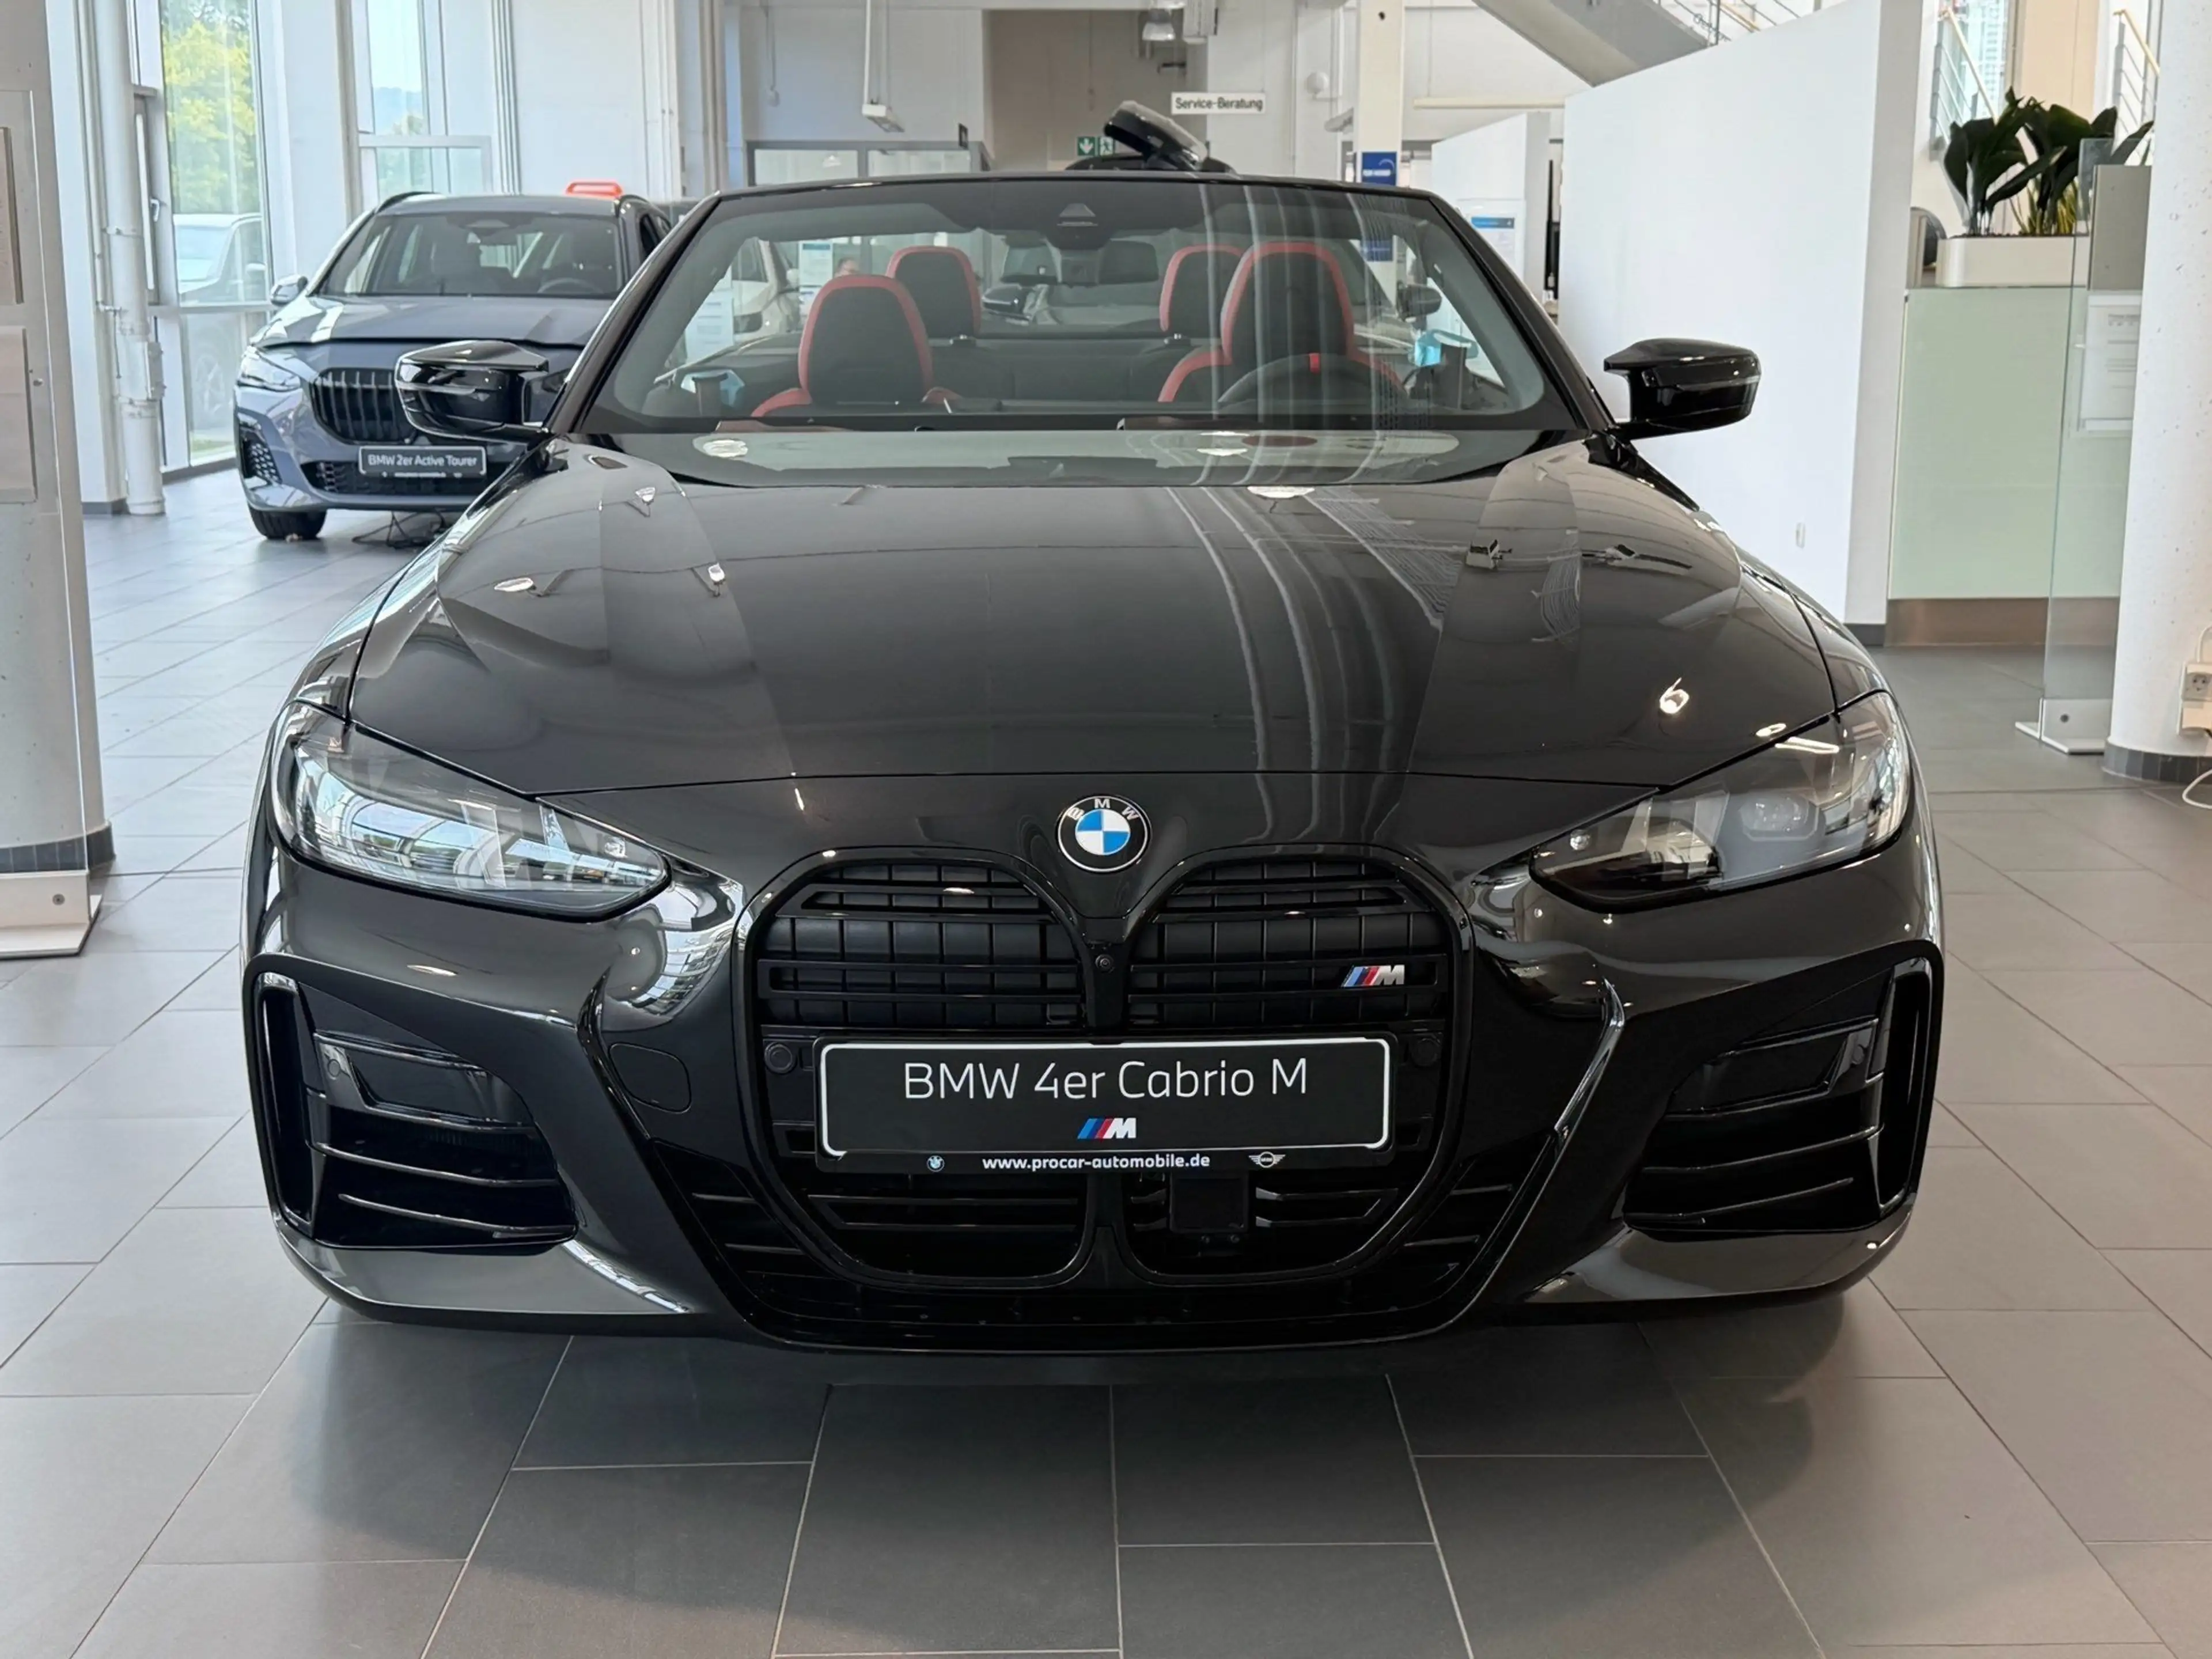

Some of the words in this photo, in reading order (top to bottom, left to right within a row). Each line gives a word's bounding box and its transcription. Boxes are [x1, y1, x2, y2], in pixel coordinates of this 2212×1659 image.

[1175, 96, 1263, 112] Service-Beratung
[368, 454, 395, 466] BMW
[396, 454, 413, 465] 2er
[414, 454, 445, 466] Active
[445, 454, 477, 467] Tourer
[1066, 798, 1140, 821] BMW
[904, 1062, 1020, 1099] BMW
[1034, 1062, 1106, 1099] 4er
[1118, 1059, 1255, 1099] Cabrio
[1272, 1058, 1306, 1094] M
[982, 1153, 1210, 1172] www.procar-automobile.de
